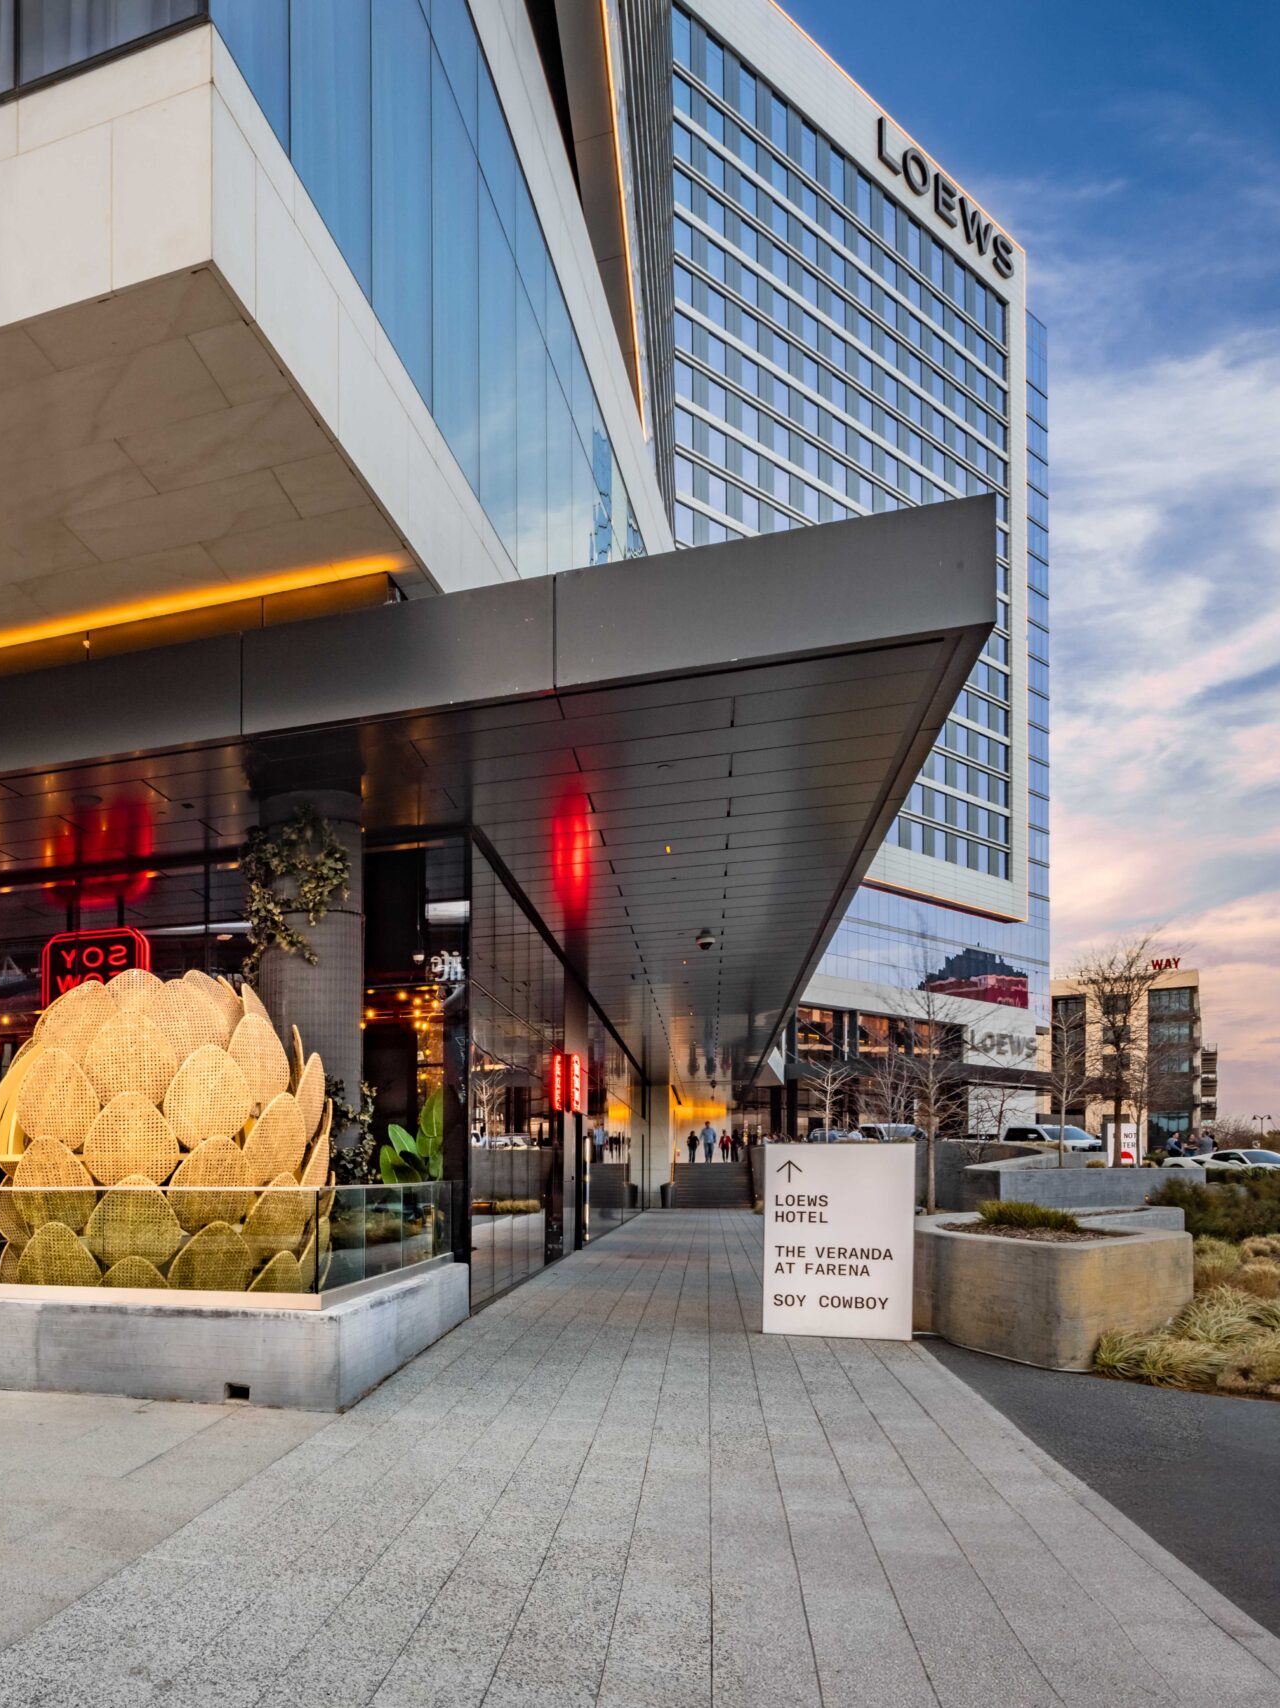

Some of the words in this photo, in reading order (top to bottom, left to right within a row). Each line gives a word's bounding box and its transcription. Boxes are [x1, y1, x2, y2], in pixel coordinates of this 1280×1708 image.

[877, 116, 1015, 279] LOEWS
[1151, 957, 1180, 971] WAY
[969, 1029, 1038, 1058] LOEWS
[774, 1194, 829, 1208] LOEWS
[774, 1211, 829, 1224] HOTEL
[774, 1245, 806, 1258] THE
[815, 1246, 893, 1261] VERANDA
[774, 1262, 796, 1274] AT
[804, 1263, 870, 1277] FARENA
[773, 1294, 807, 1307] SOY
[818, 1295, 889, 1310] COWBOY
